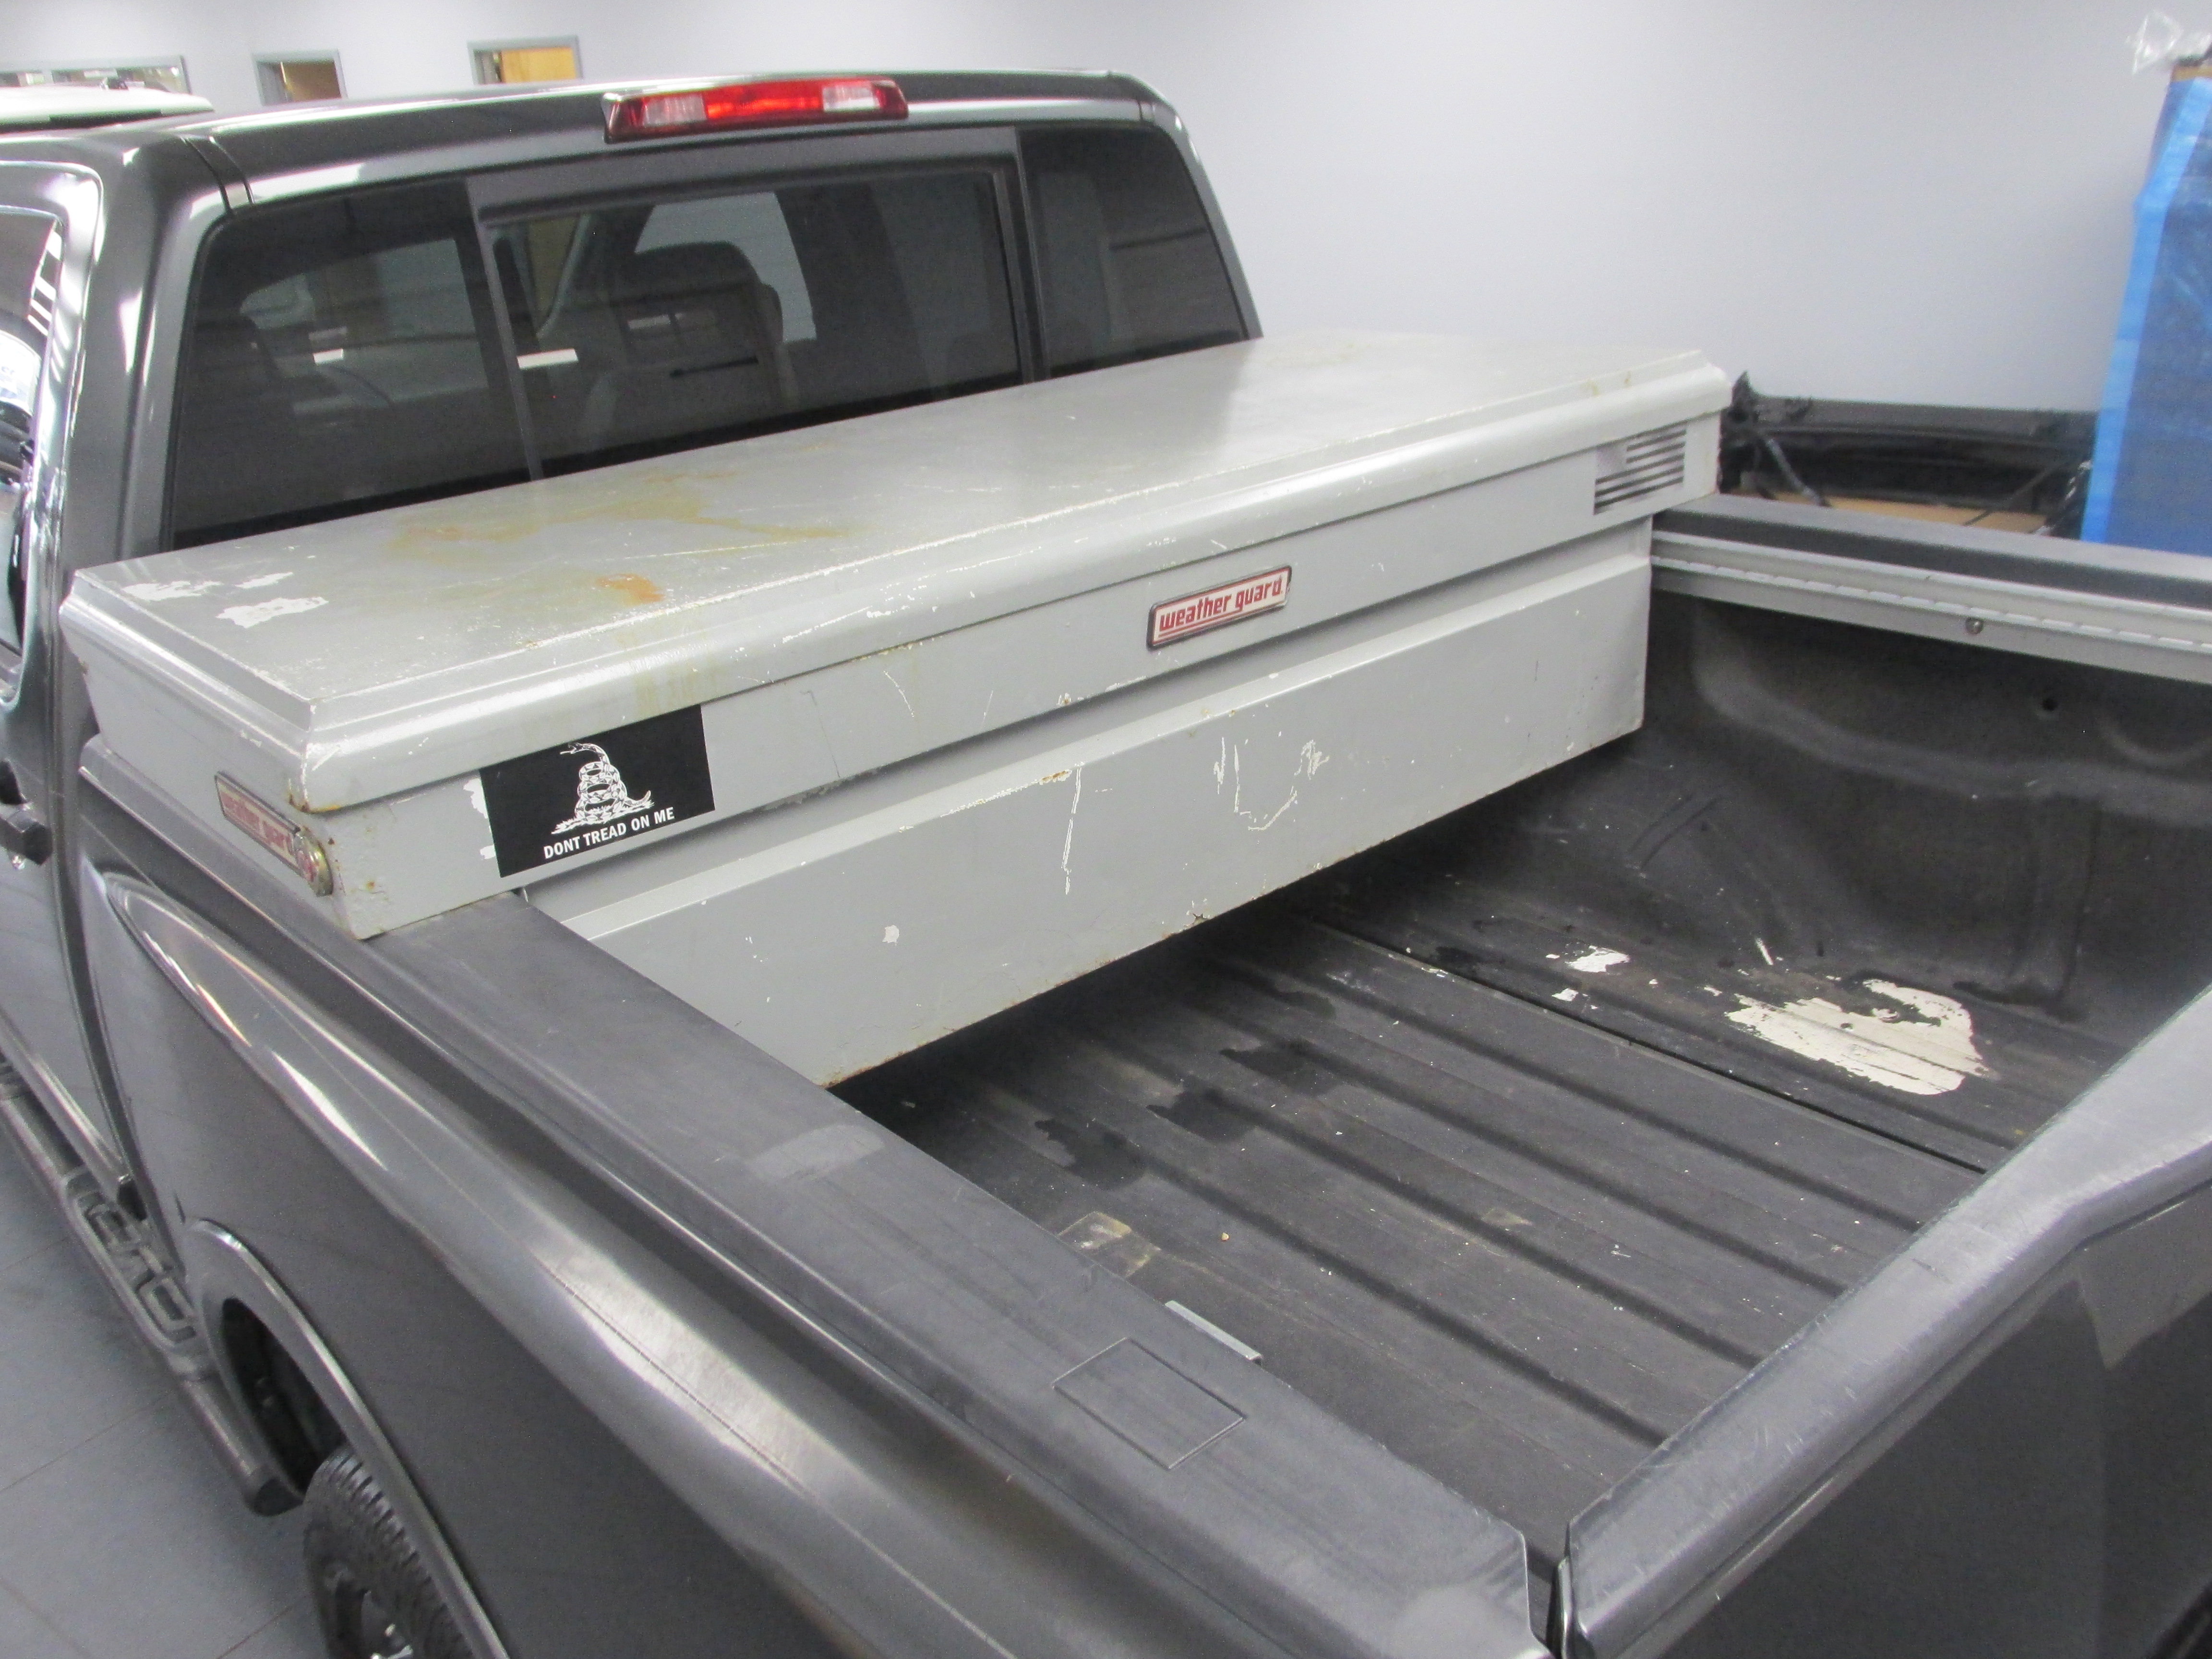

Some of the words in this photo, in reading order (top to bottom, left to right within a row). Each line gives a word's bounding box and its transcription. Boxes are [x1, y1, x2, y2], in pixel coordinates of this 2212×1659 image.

[1160, 596, 1231, 631] weather
[1235, 575, 1282, 610] guard
[543, 836, 580, 859] DONT
[583, 823, 626, 846] TREAD
[631, 815, 649, 831] ON
[654, 807, 674, 824] ME
